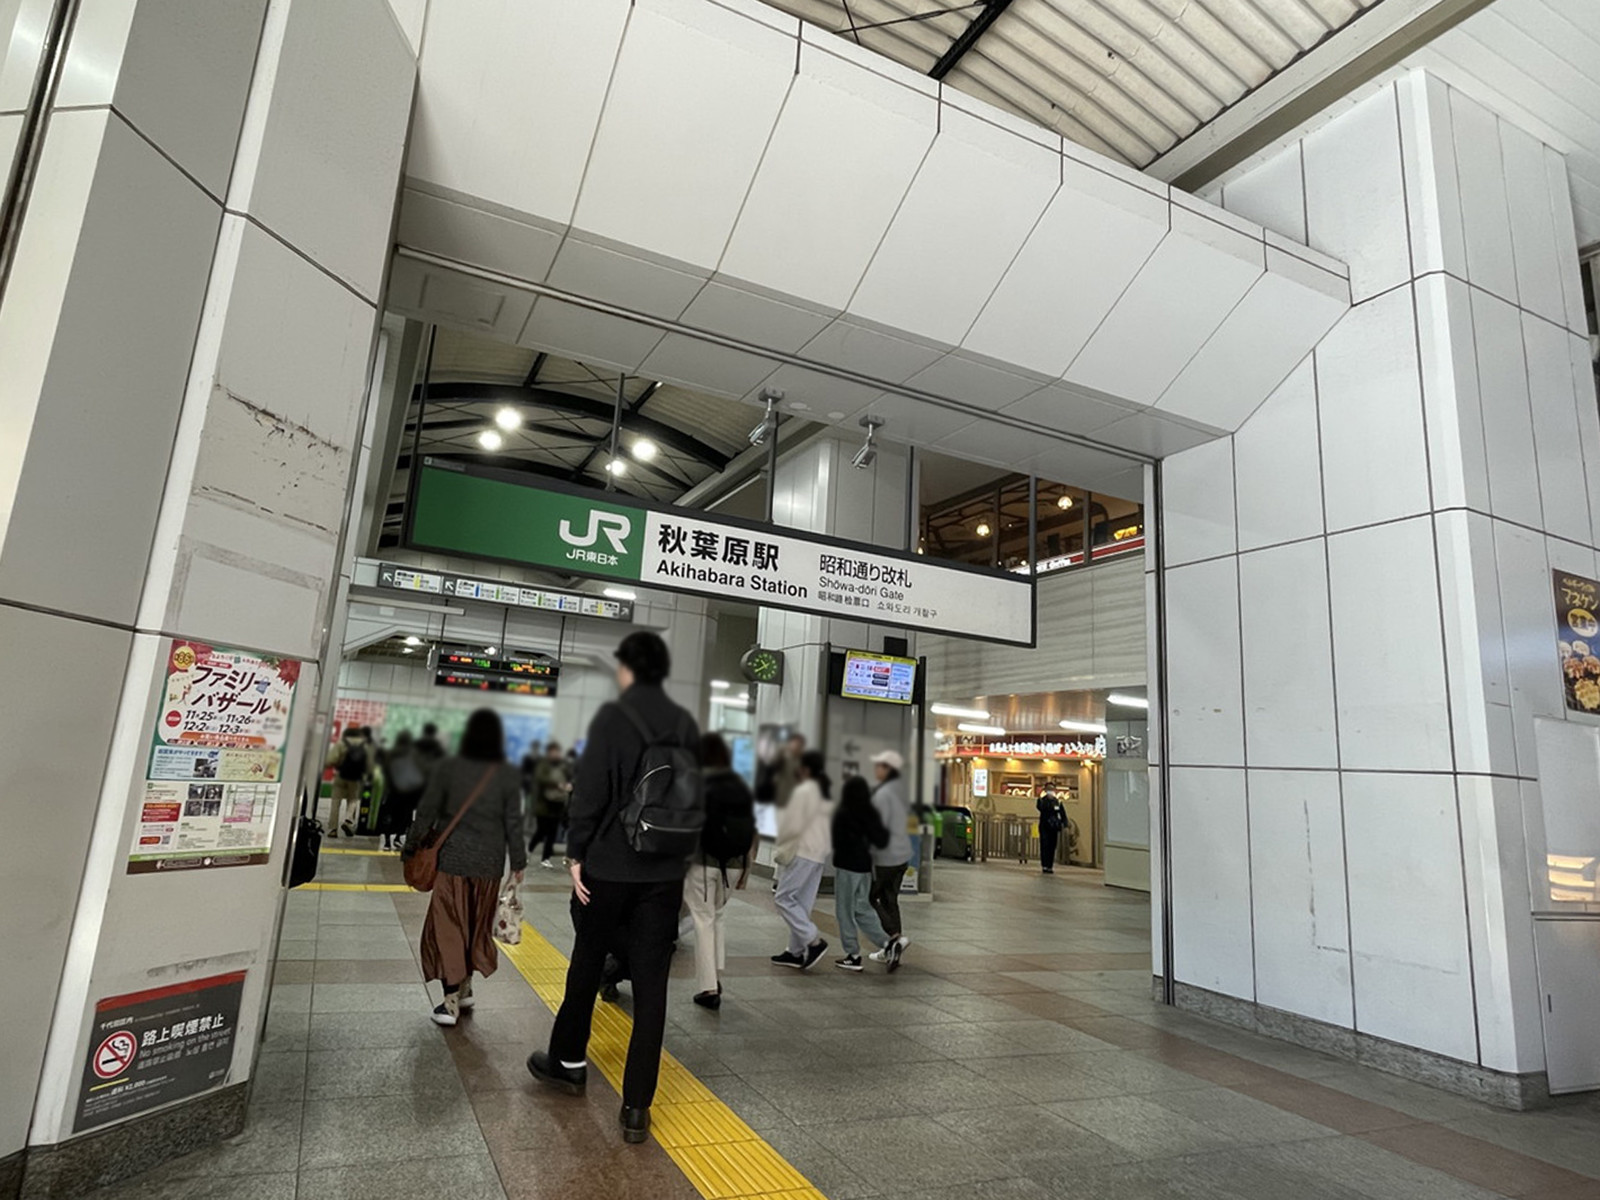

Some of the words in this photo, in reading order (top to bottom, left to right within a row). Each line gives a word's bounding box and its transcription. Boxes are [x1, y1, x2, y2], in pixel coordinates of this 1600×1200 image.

[559, 509, 631, 555] JR
[658, 524, 779, 572] 秋葉原駅
[566, 548, 619, 566] JR東日本
[819, 554, 913, 588] 昭和通り改札
[656, 559, 746, 588] Akihabara
[750, 575, 808, 598] Station
[880, 587, 904, 601] Gate
[192, 666, 271, 692] ファミリー
[191, 691, 272, 716] バザール
[141, 1013, 224, 1047] 路上喫煙禁止
